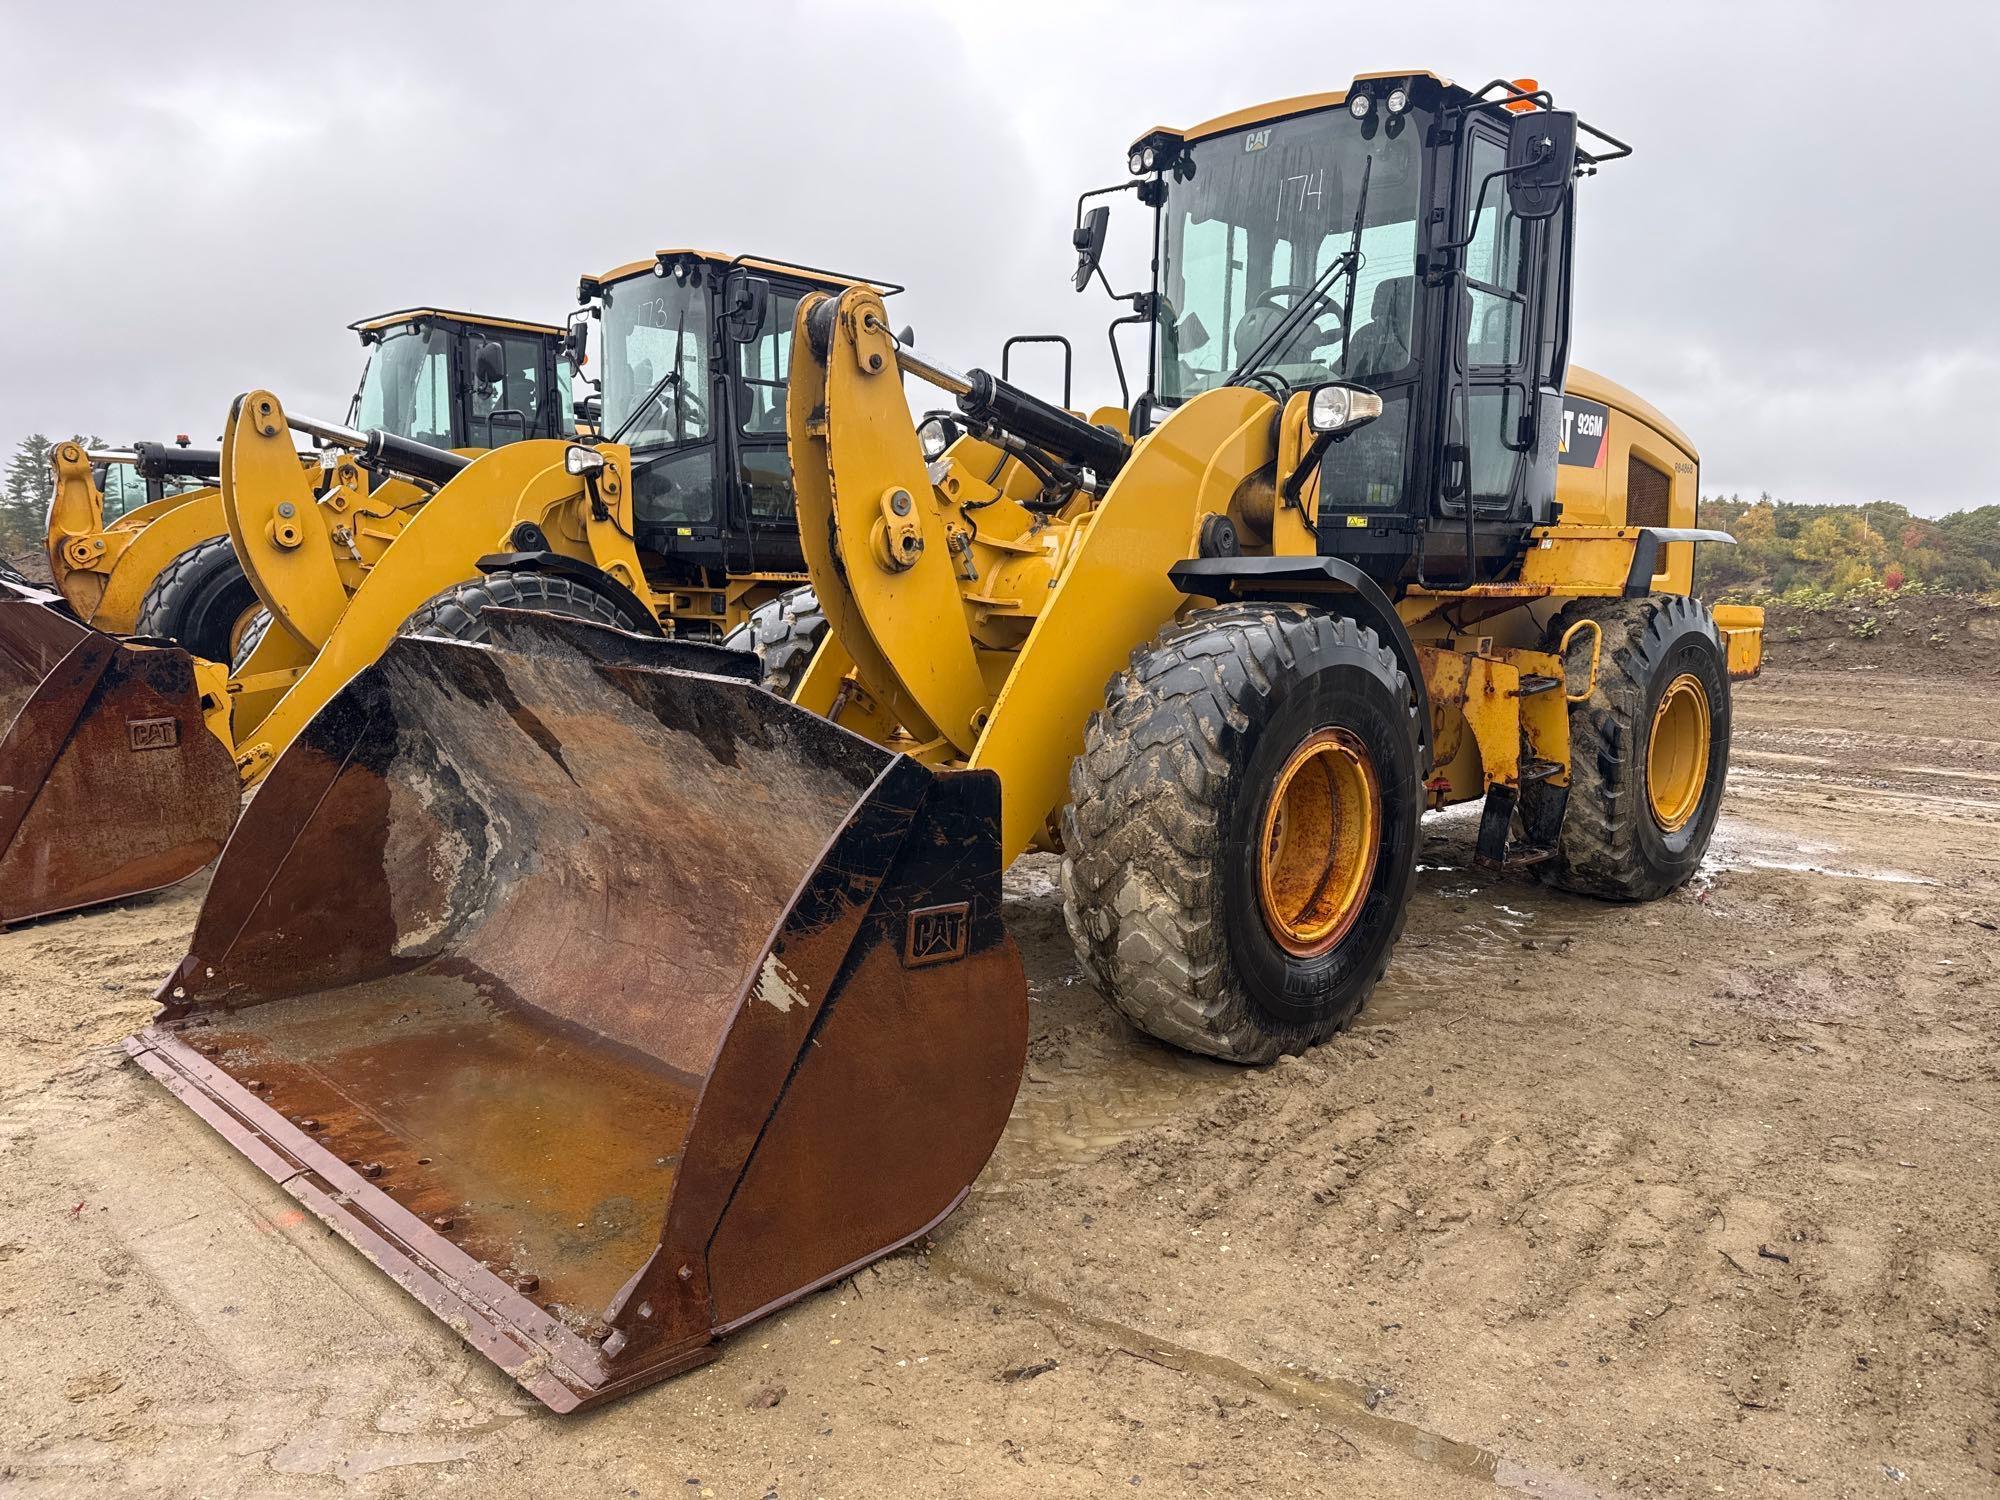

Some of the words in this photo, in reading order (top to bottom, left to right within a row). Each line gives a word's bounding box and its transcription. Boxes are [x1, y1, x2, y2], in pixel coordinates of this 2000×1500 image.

[1245, 129, 1272, 152] CAT
[1276, 169, 1323, 221] 174
[637, 297, 667, 327] 173
[1577, 413, 1603, 437] 926M
[133, 722, 172, 746] CAT
[914, 911, 963, 957] CAT
